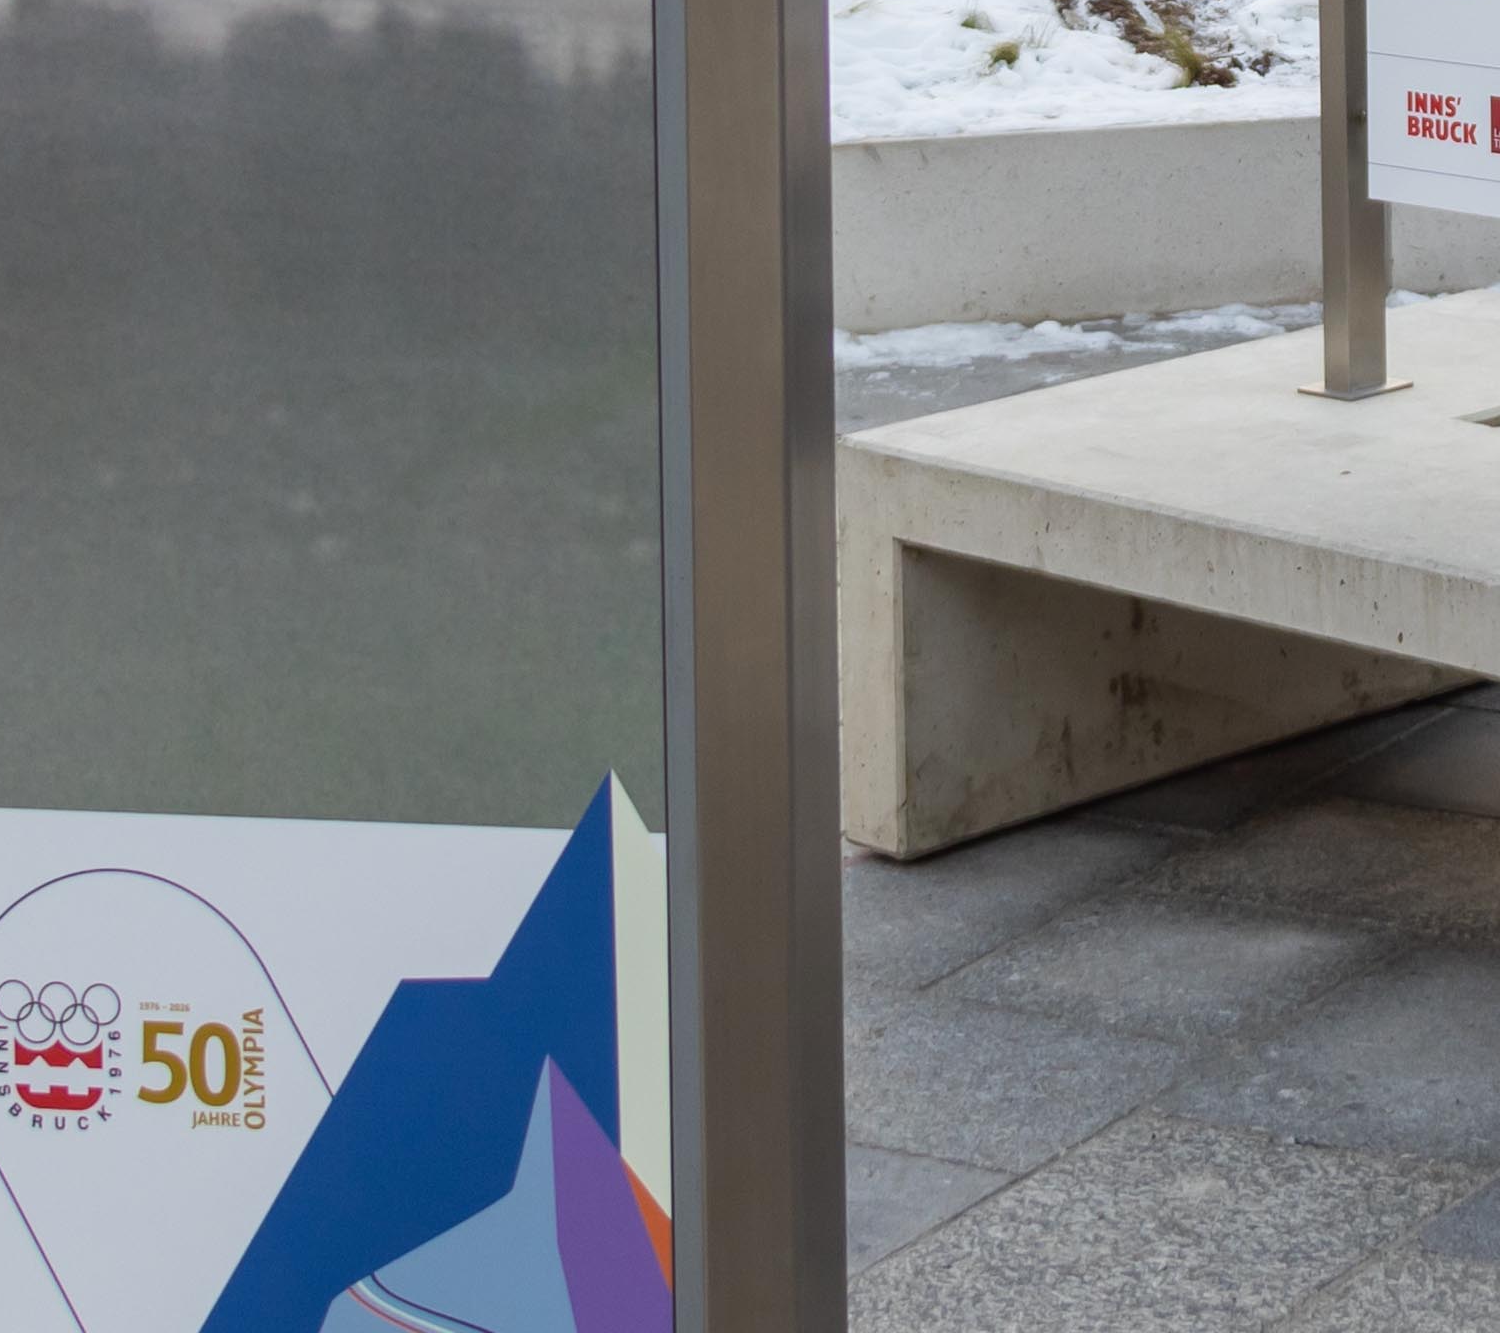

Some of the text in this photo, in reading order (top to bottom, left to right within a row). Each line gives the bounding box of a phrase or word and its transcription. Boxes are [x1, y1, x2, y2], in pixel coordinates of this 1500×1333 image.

[1407, 115, 1477, 145] BRUCK
[139, 1001, 161, 1012] 1976
[137, 1020, 242, 1107] 50
[242, 1007, 266, 1130] OLYMPIA
[191, 1110, 242, 1129] JAHRE
